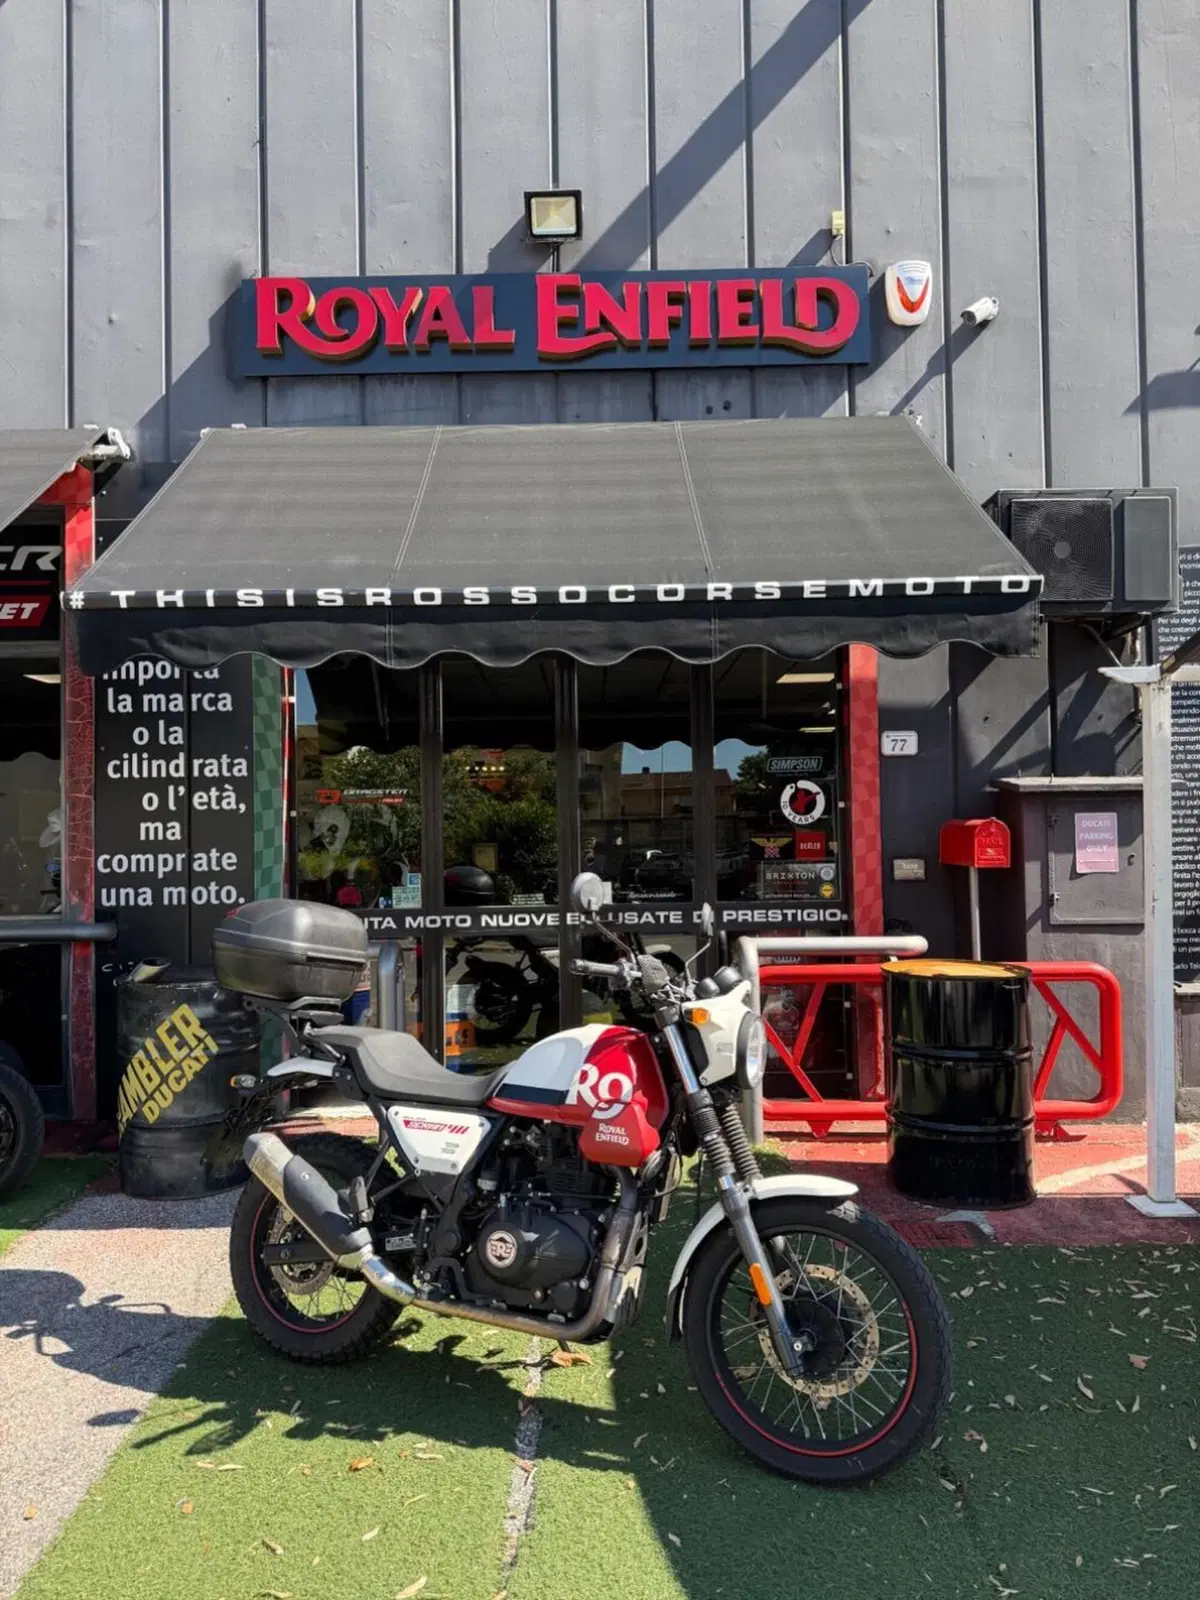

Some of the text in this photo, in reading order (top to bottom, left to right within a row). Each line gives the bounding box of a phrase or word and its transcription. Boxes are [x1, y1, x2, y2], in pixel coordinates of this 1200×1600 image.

[256, 273, 860, 360] ROYAL ENFIELD
[0, 603, 40, 619] ET
[103, 660, 220, 686] mpoa
[107, 687, 233, 713] la marca
[132, 719, 184, 745] o la
[890, 739, 908, 752] 77
[107, 752, 248, 779] cilindrata
[770, 758, 819, 771] SIMPSON
[142, 791, 159, 811] o
[139, 821, 182, 841] ma
[1081, 819, 1111, 828] DUCATI
[1078, 832, 1114, 841] PARKING
[97, 848, 238, 879] comprate
[101, 880, 246, 907] una moto.
[404, 914, 471, 928] MOTO
[480, 913, 560, 927] NUOVE
[608, 911, 683, 925] USATE
[722, 908, 849, 923] PRESTIGIO.
[142, 1035, 219, 1124] DUCATI
[595, 1131, 630, 1146] ENFIELD
[598, 1122, 627, 1135] ROYAL
